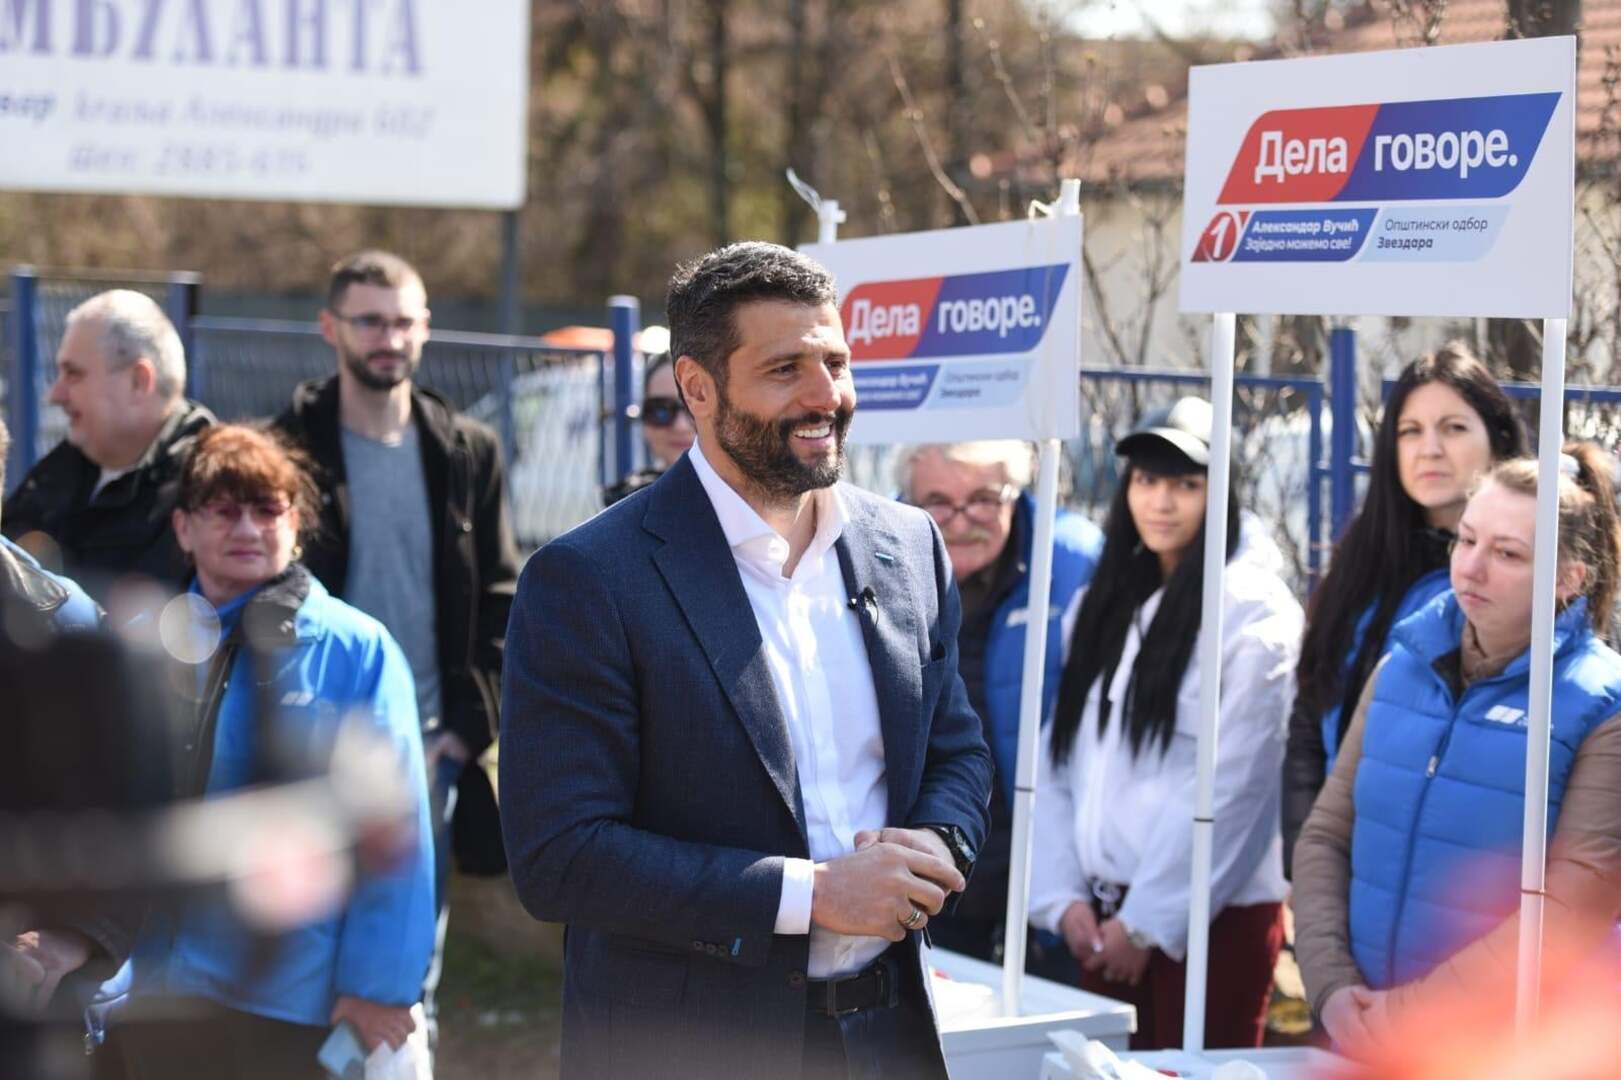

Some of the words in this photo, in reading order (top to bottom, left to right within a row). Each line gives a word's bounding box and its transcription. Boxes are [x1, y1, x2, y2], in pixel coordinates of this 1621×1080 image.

[1253, 130, 1348, 184] Дела
[1373, 129, 1518, 180] говоре.
[1251, 220, 1320, 235] Александар
[1322, 218, 1360, 236] Вучић
[1384, 218, 1449, 232] Општински
[1451, 216, 1489, 233] одбор
[1245, 236, 1286, 253] Заједно
[1286, 238, 1329, 251] можемо
[1376, 236, 1434, 251] Звездара
[848, 298, 921, 346] Дела
[937, 294, 1041, 339] говоре.
